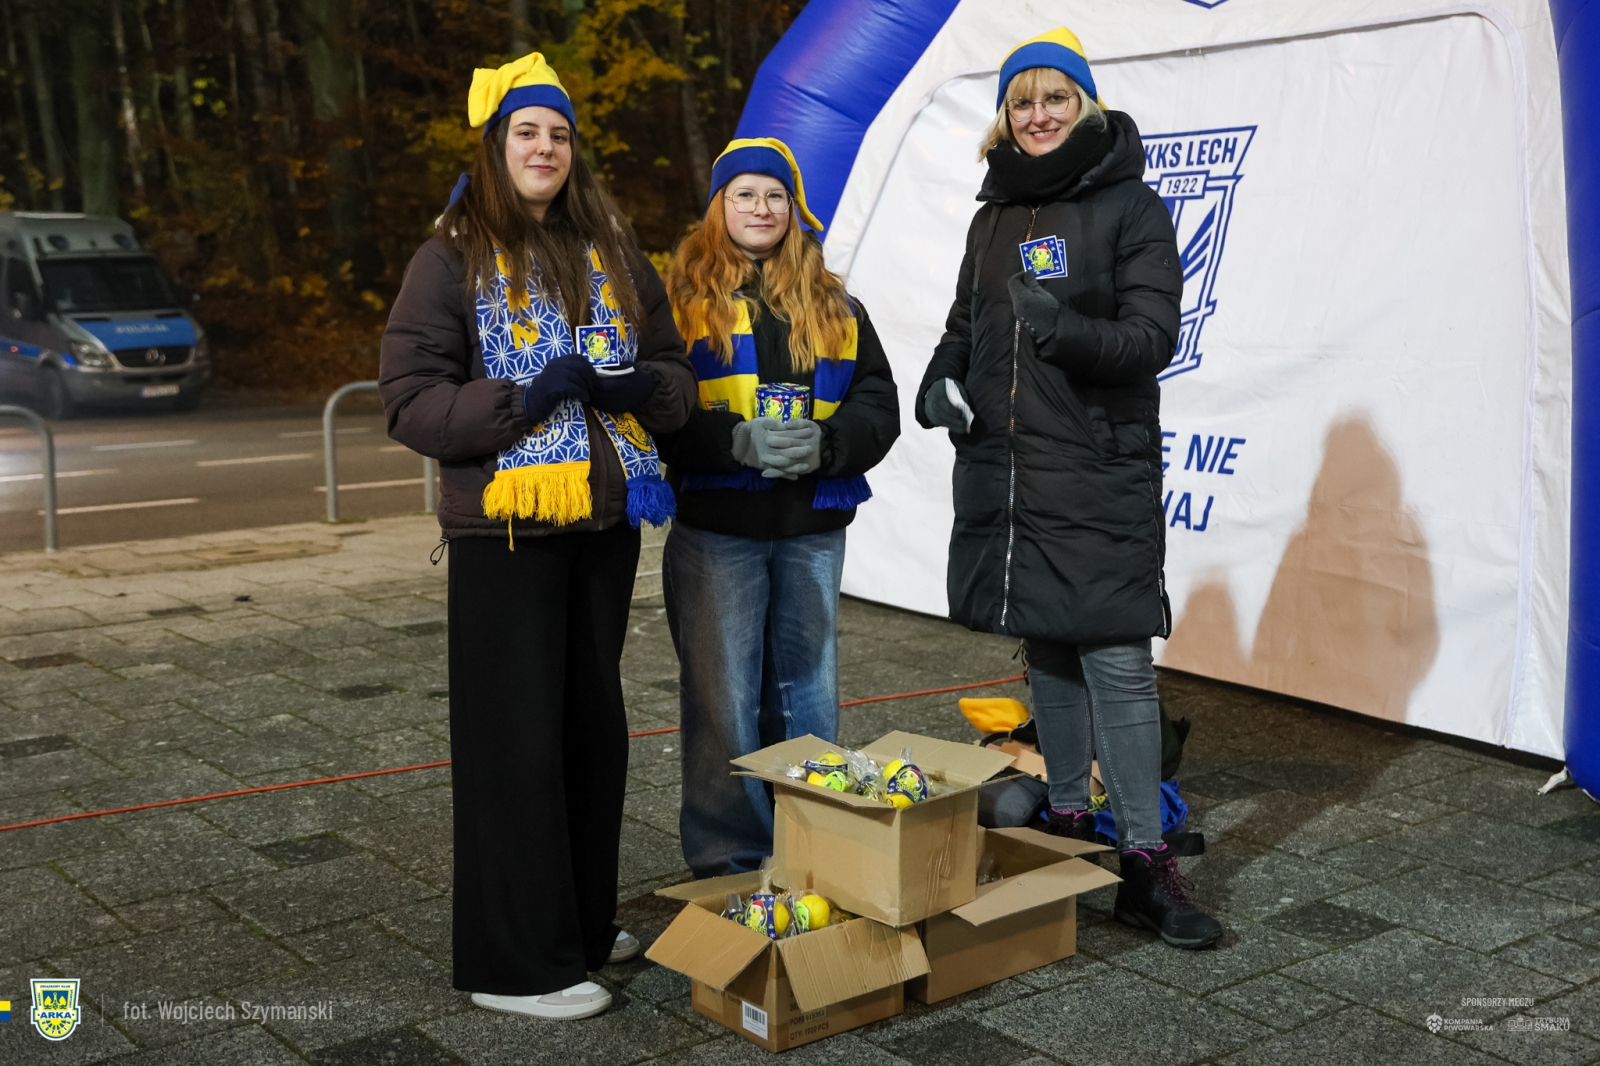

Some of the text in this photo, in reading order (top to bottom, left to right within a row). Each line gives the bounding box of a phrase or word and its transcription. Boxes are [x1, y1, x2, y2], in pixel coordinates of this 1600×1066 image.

[1144, 137, 1238, 169] KKS LECH
[1166, 177, 1199, 195] 1922
[1184, 433, 1247, 475] NIE
